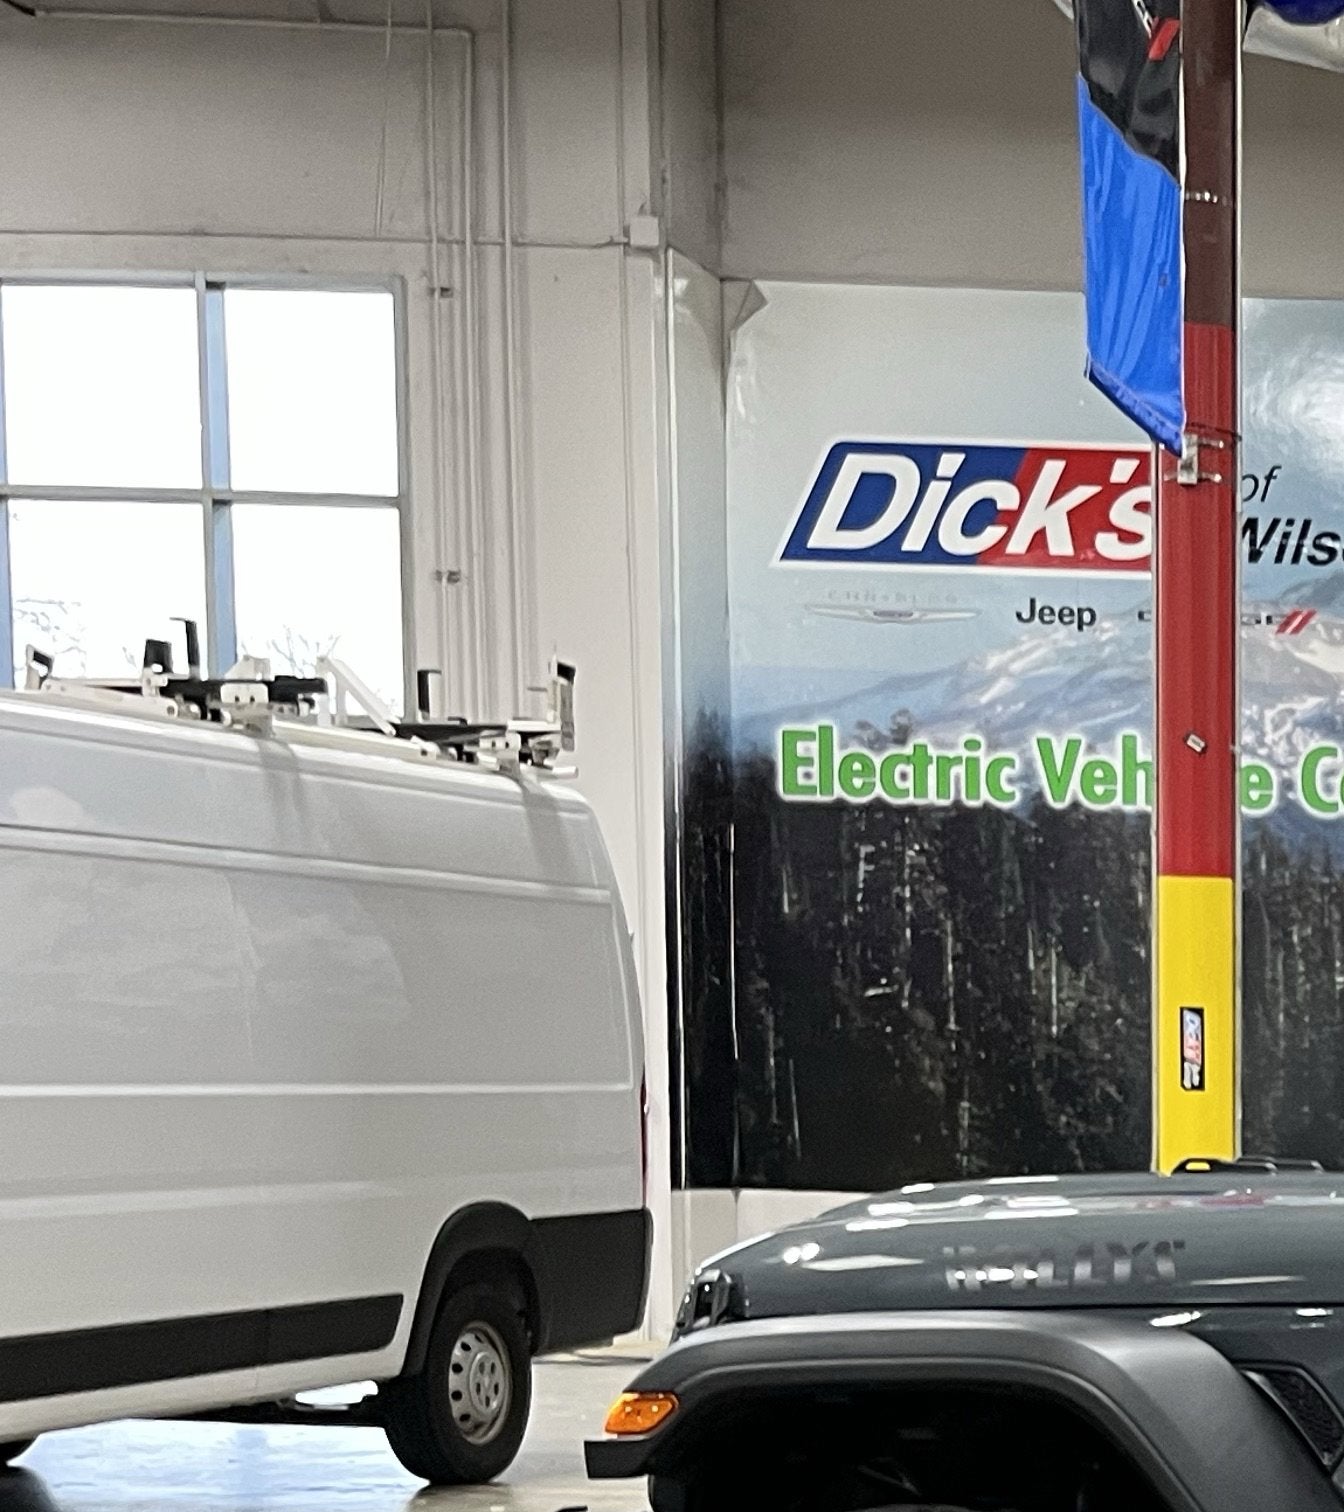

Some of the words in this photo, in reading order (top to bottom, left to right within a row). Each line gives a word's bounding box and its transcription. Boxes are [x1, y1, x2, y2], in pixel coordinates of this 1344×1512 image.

[806, 453, 1152, 561] Dick's
[1015, 598, 1097, 631] Jeep
[782, 725, 1016, 803] Electric
[1037, 734, 1274, 810] Vehe
